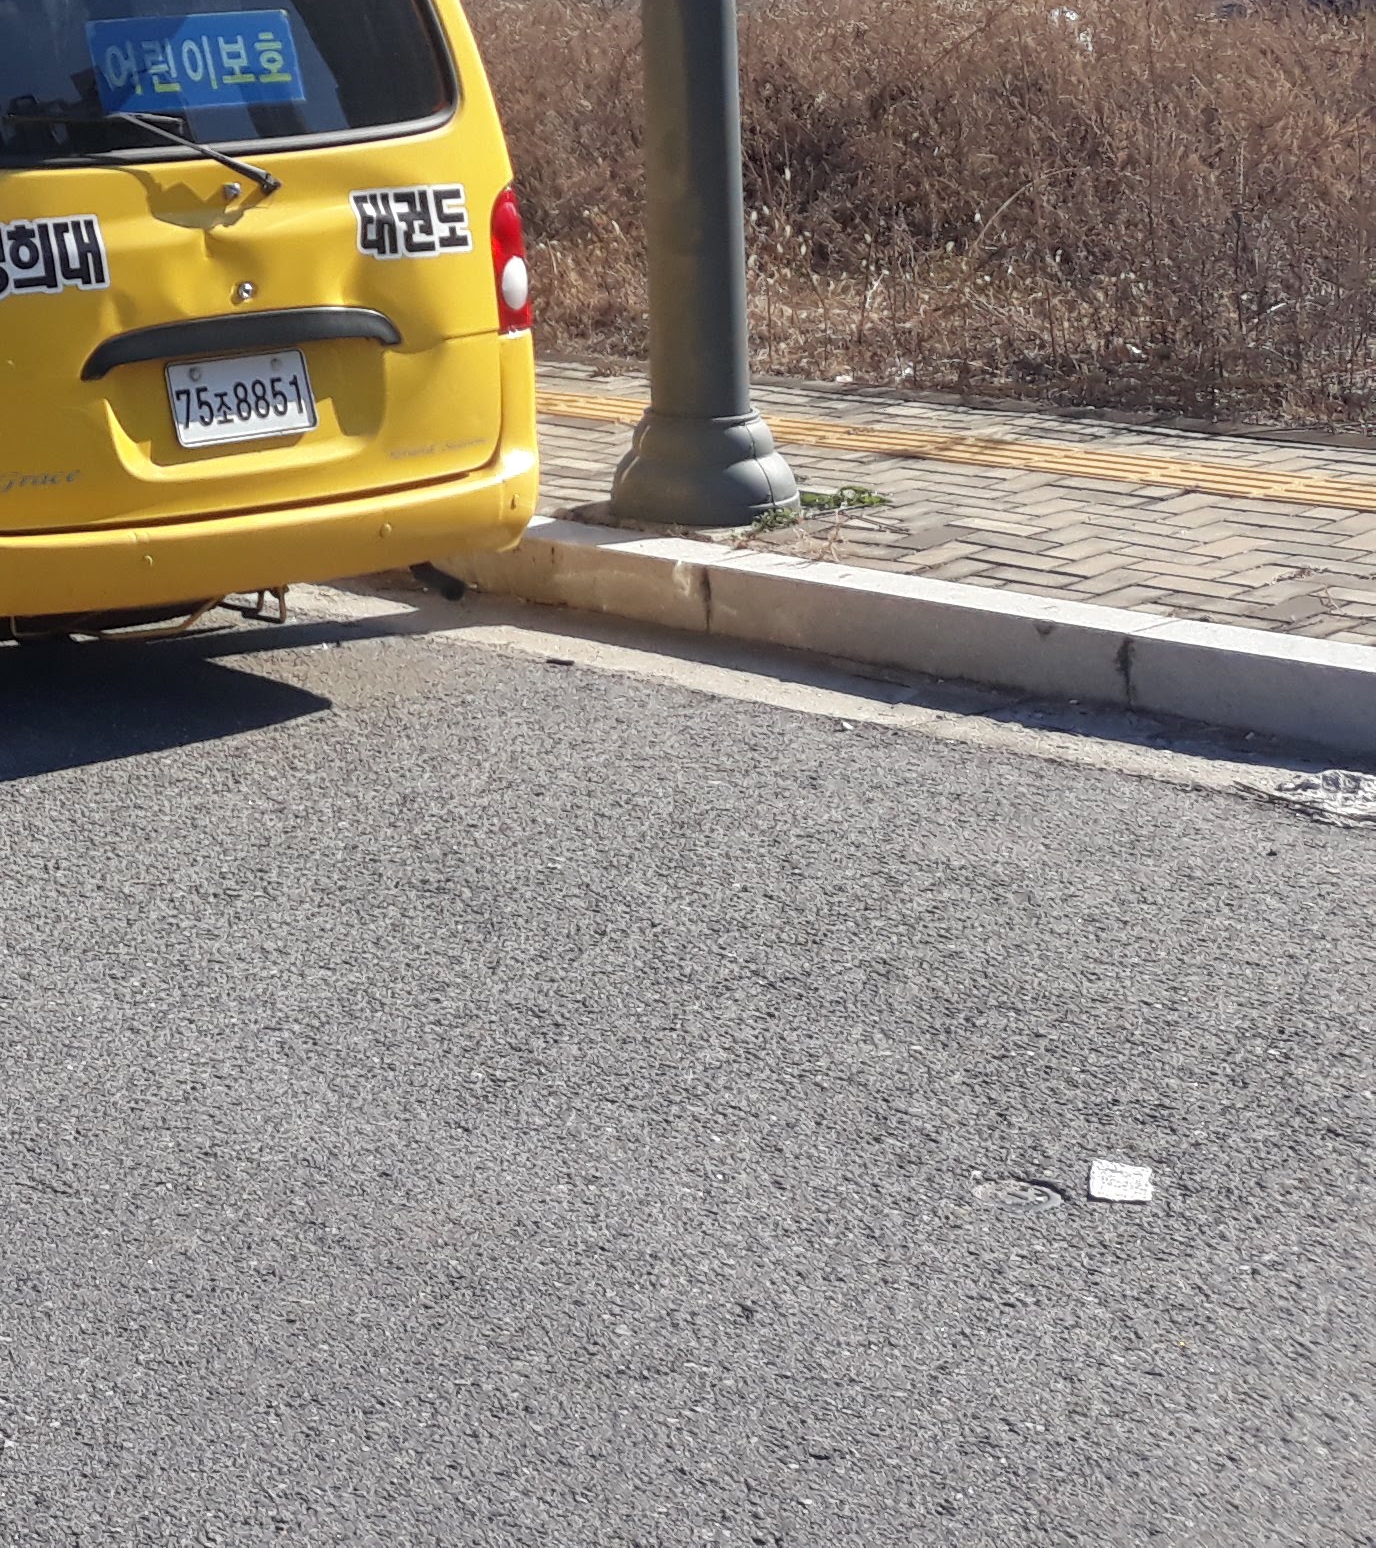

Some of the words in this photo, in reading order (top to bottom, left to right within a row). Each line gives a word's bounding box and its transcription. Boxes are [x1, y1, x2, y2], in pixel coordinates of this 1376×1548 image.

[105, 31, 293, 95] 어린이보호
[352, 188, 470, 256] 태권도
[174, 374, 305, 430] 75조8851
